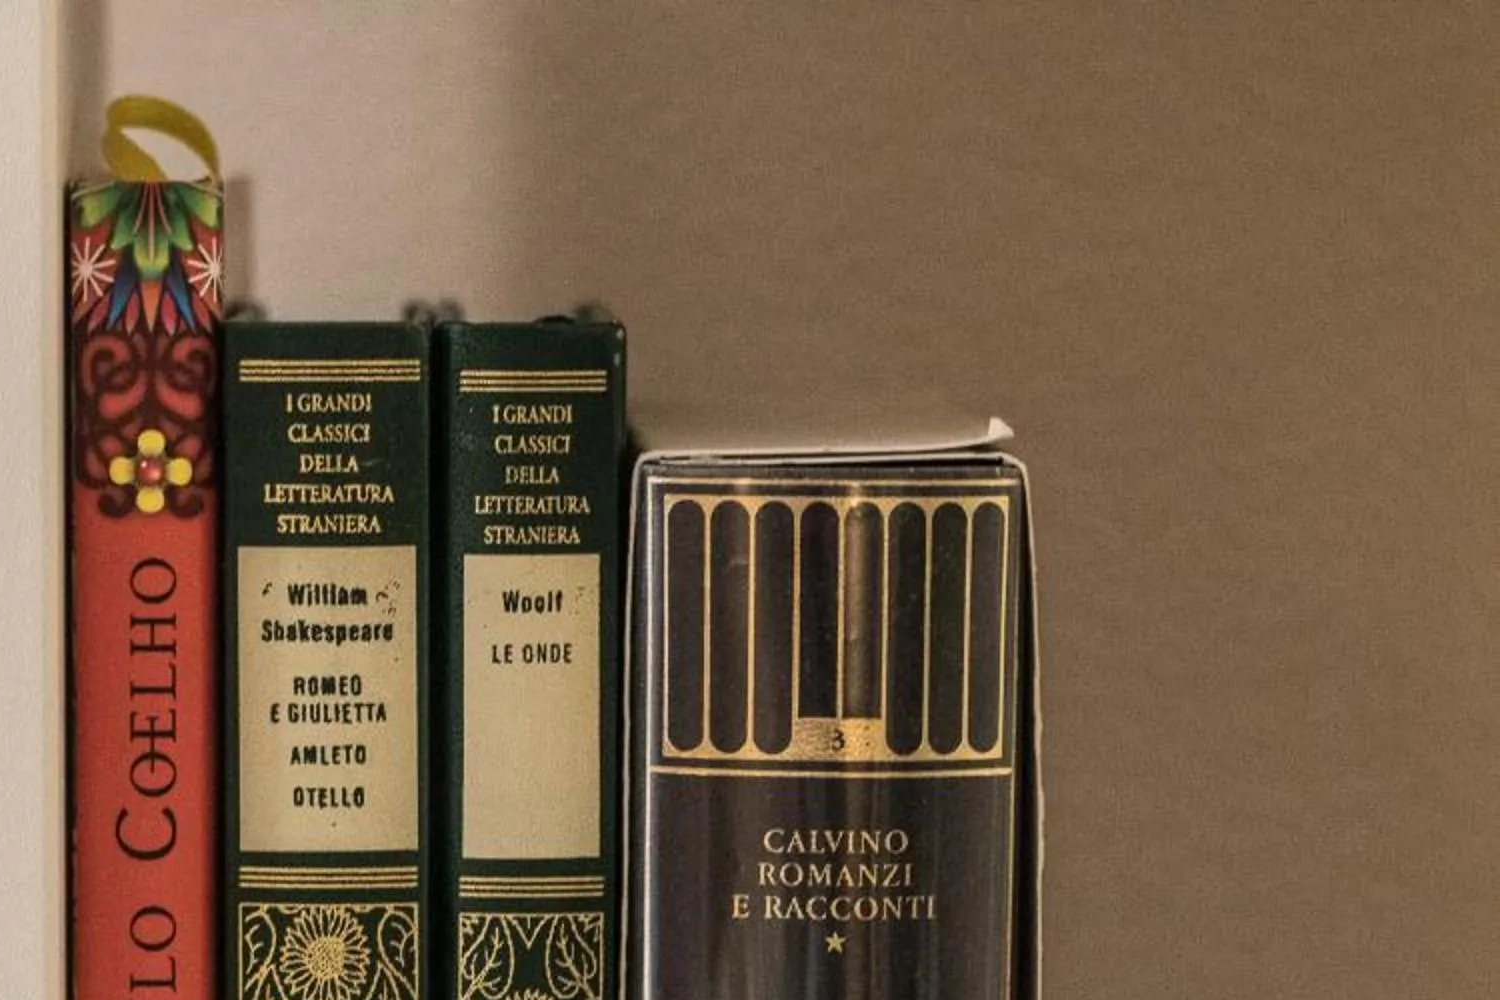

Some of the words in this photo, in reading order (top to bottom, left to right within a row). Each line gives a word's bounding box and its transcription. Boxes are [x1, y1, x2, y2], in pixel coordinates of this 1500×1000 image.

[286, 394, 295, 413] I
[297, 394, 372, 413] GRANDI
[492, 404, 501, 424] I
[503, 404, 573, 424] GRANDI
[287, 424, 371, 443] CLASSICI
[494, 435, 571, 454] CLASSICI
[299, 454, 359, 473] DELLA
[505, 465, 559, 485] DELLA
[264, 483, 395, 504] LETTERATURA
[474, 495, 591, 515] LETTERATURA
[276, 514, 382, 534] STRANIERA
[483, 525, 581, 545] STRANIERA
[287, 583, 368, 607] William
[502, 590, 564, 615] Woolf
[261, 619, 394, 645] Shakespeare
[491, 644, 514, 665] LE
[522, 644, 573, 665] ONDE
[293, 675, 362, 698] ROMEO
[115, 557, 177, 860] COELHO
[270, 702, 280, 724] E
[288, 702, 387, 724] GIULIETTA
[830, 730, 846, 752] 3
[290, 745, 367, 766] AMLETO
[293, 788, 365, 809] OTELLO
[763, 828, 909, 855] CALVINO
[757, 861, 913, 888] ROMANZI
[732, 894, 749, 920] E
[764, 894, 937, 921] RACCONTI
